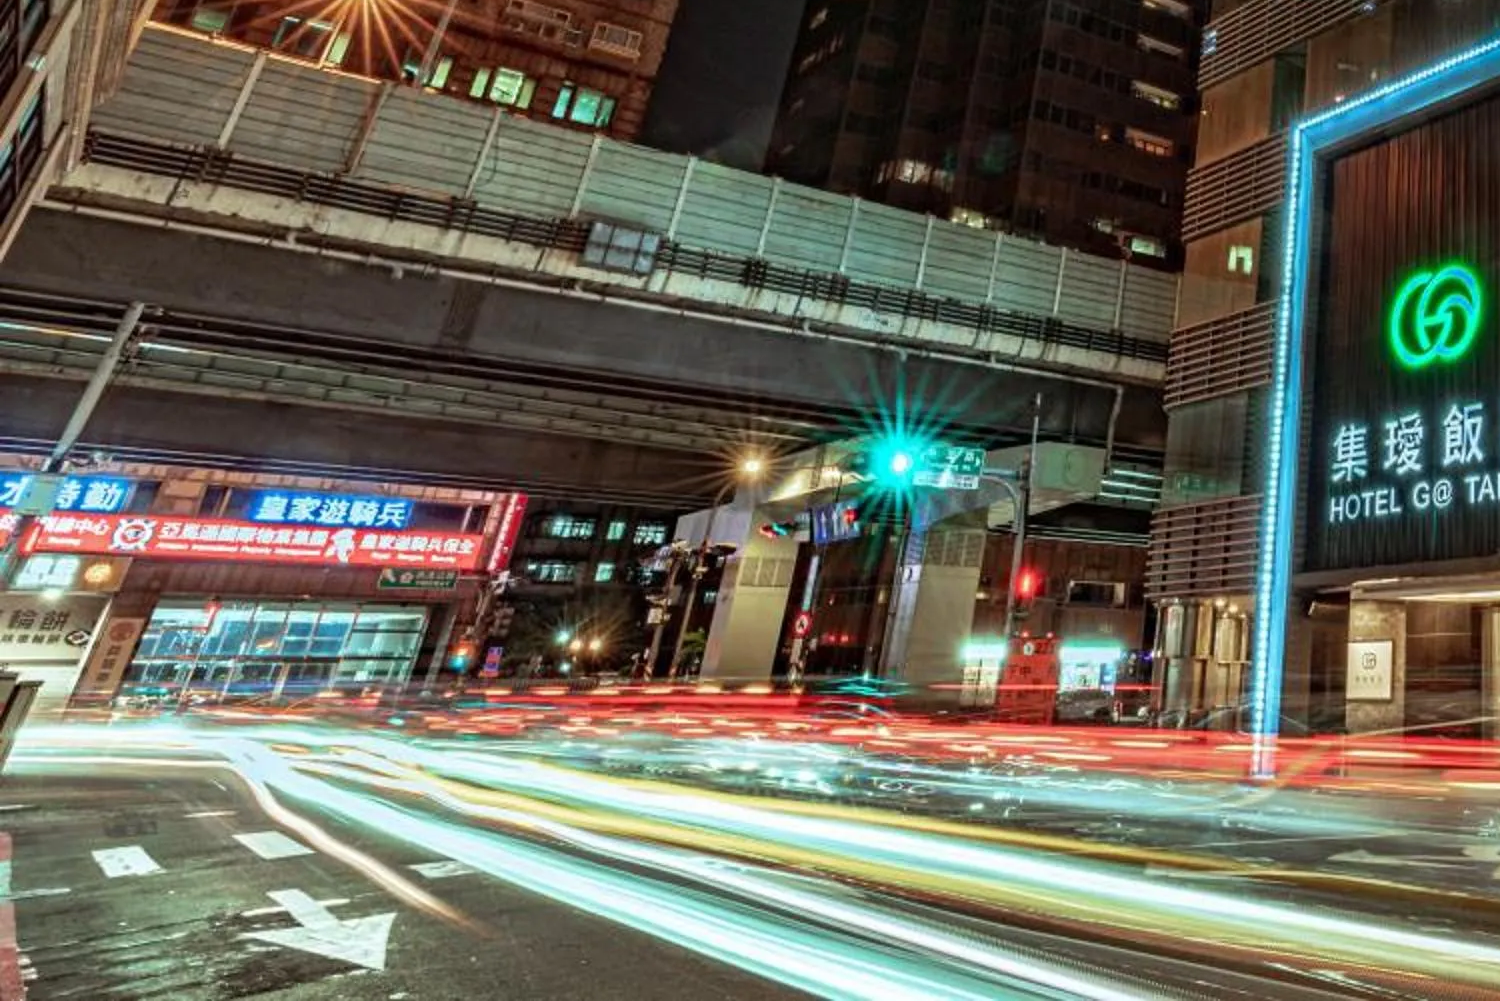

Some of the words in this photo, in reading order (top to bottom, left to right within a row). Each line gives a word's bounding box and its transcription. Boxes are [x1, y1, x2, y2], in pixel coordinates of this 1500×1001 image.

[254, 494, 408, 528] 皇家遊騎兵
[1328, 486, 1403, 523] HOTEL
[1412, 478, 1453, 509] G@
